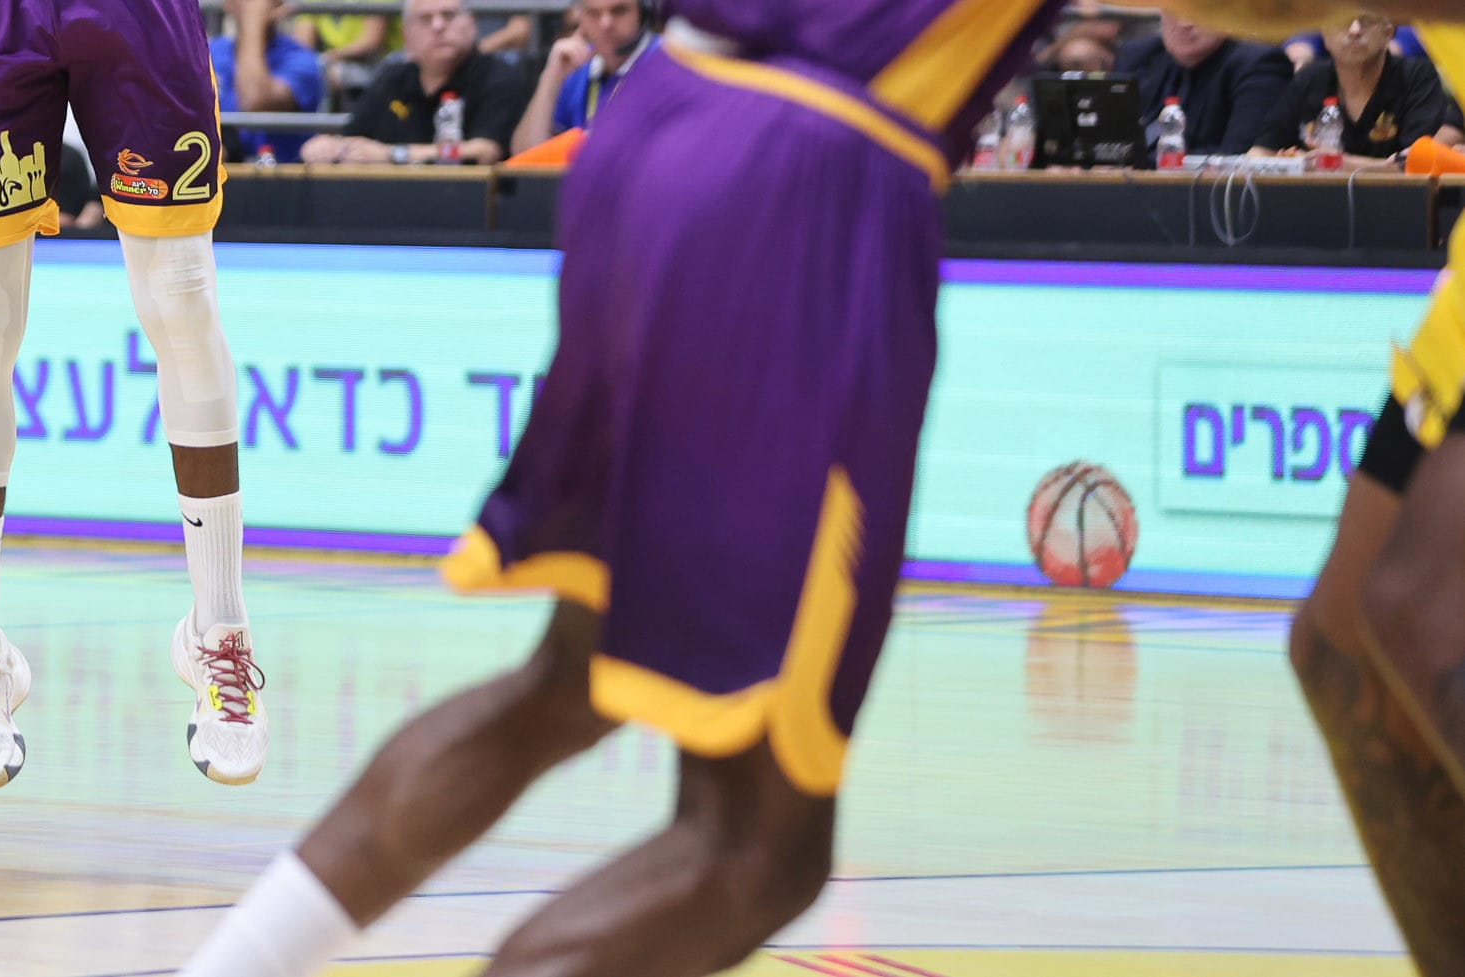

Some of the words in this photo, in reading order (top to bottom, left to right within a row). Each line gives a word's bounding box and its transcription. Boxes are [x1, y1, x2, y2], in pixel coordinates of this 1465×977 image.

[115, 182, 147, 195] Winner
[172, 131, 211, 200] 2
[1183, 404, 1375, 482] ספרים
